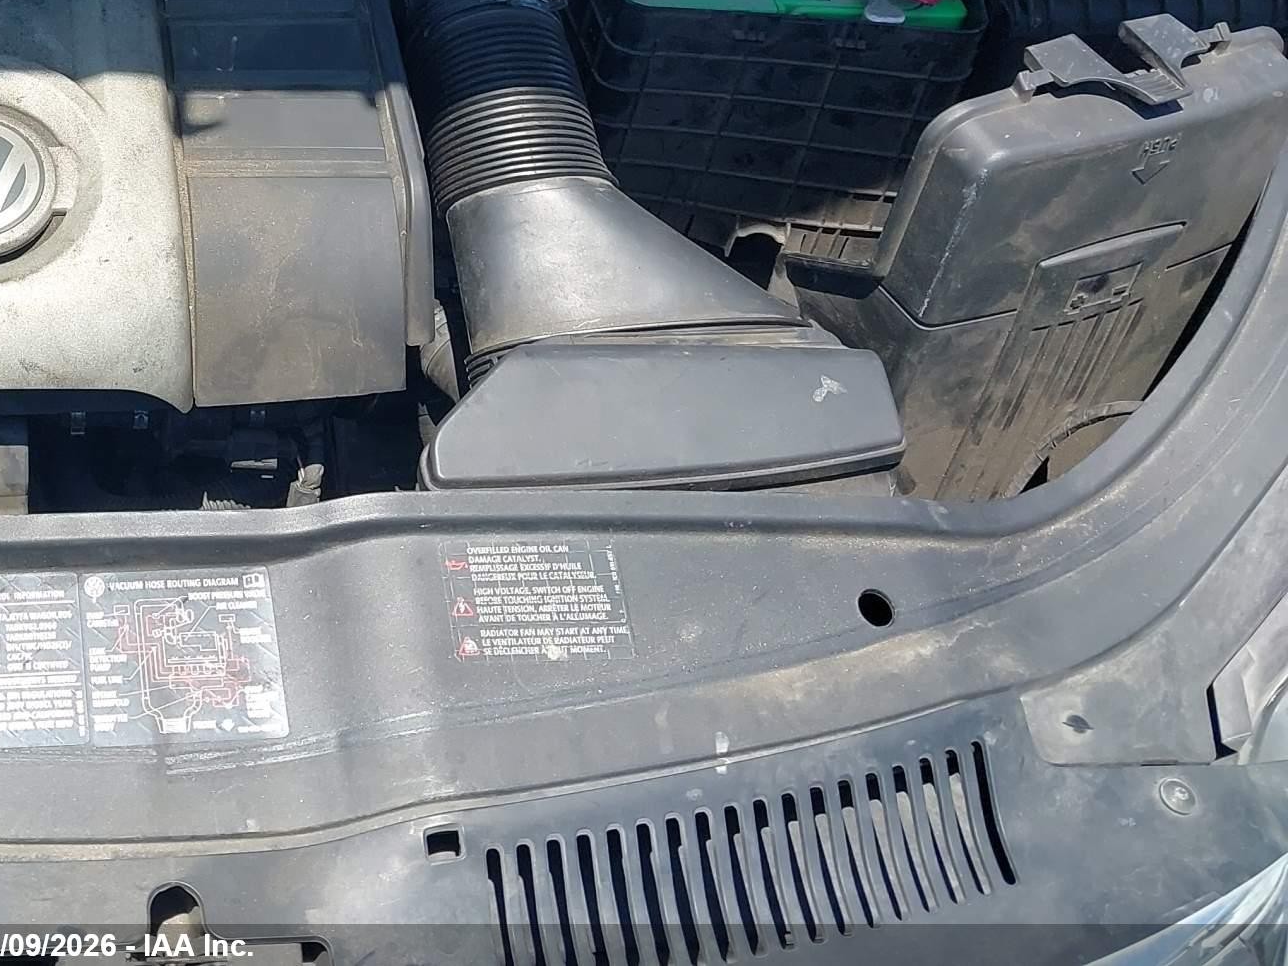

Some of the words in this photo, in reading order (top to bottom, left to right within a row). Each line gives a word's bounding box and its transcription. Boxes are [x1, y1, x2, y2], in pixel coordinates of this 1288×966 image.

[468, 555, 501, 563] DAMAGE
[470, 564, 518, 572] REMPLISSAGE
[520, 563, 550, 571] EXCESSIF
[471, 573, 516, 581] DANGEREUX
[518, 572, 538, 580] POUR
[549, 571, 596, 579] CATALYSEUR.
[110, 581, 143, 591] VACUUM
[145, 581, 165, 589] HOSE
[167, 579, 201, 588] ROUTING
[203, 577, 238, 587] DIAGRAM
[14, 590, 65, 600] INFORMATION
[504, 596, 543, 604] TOUCHING
[544, 595, 578, 603] IGNITION
[480, 629, 519, 637] RADIATOR
[554, 636, 595, 644] RADIATEUR
